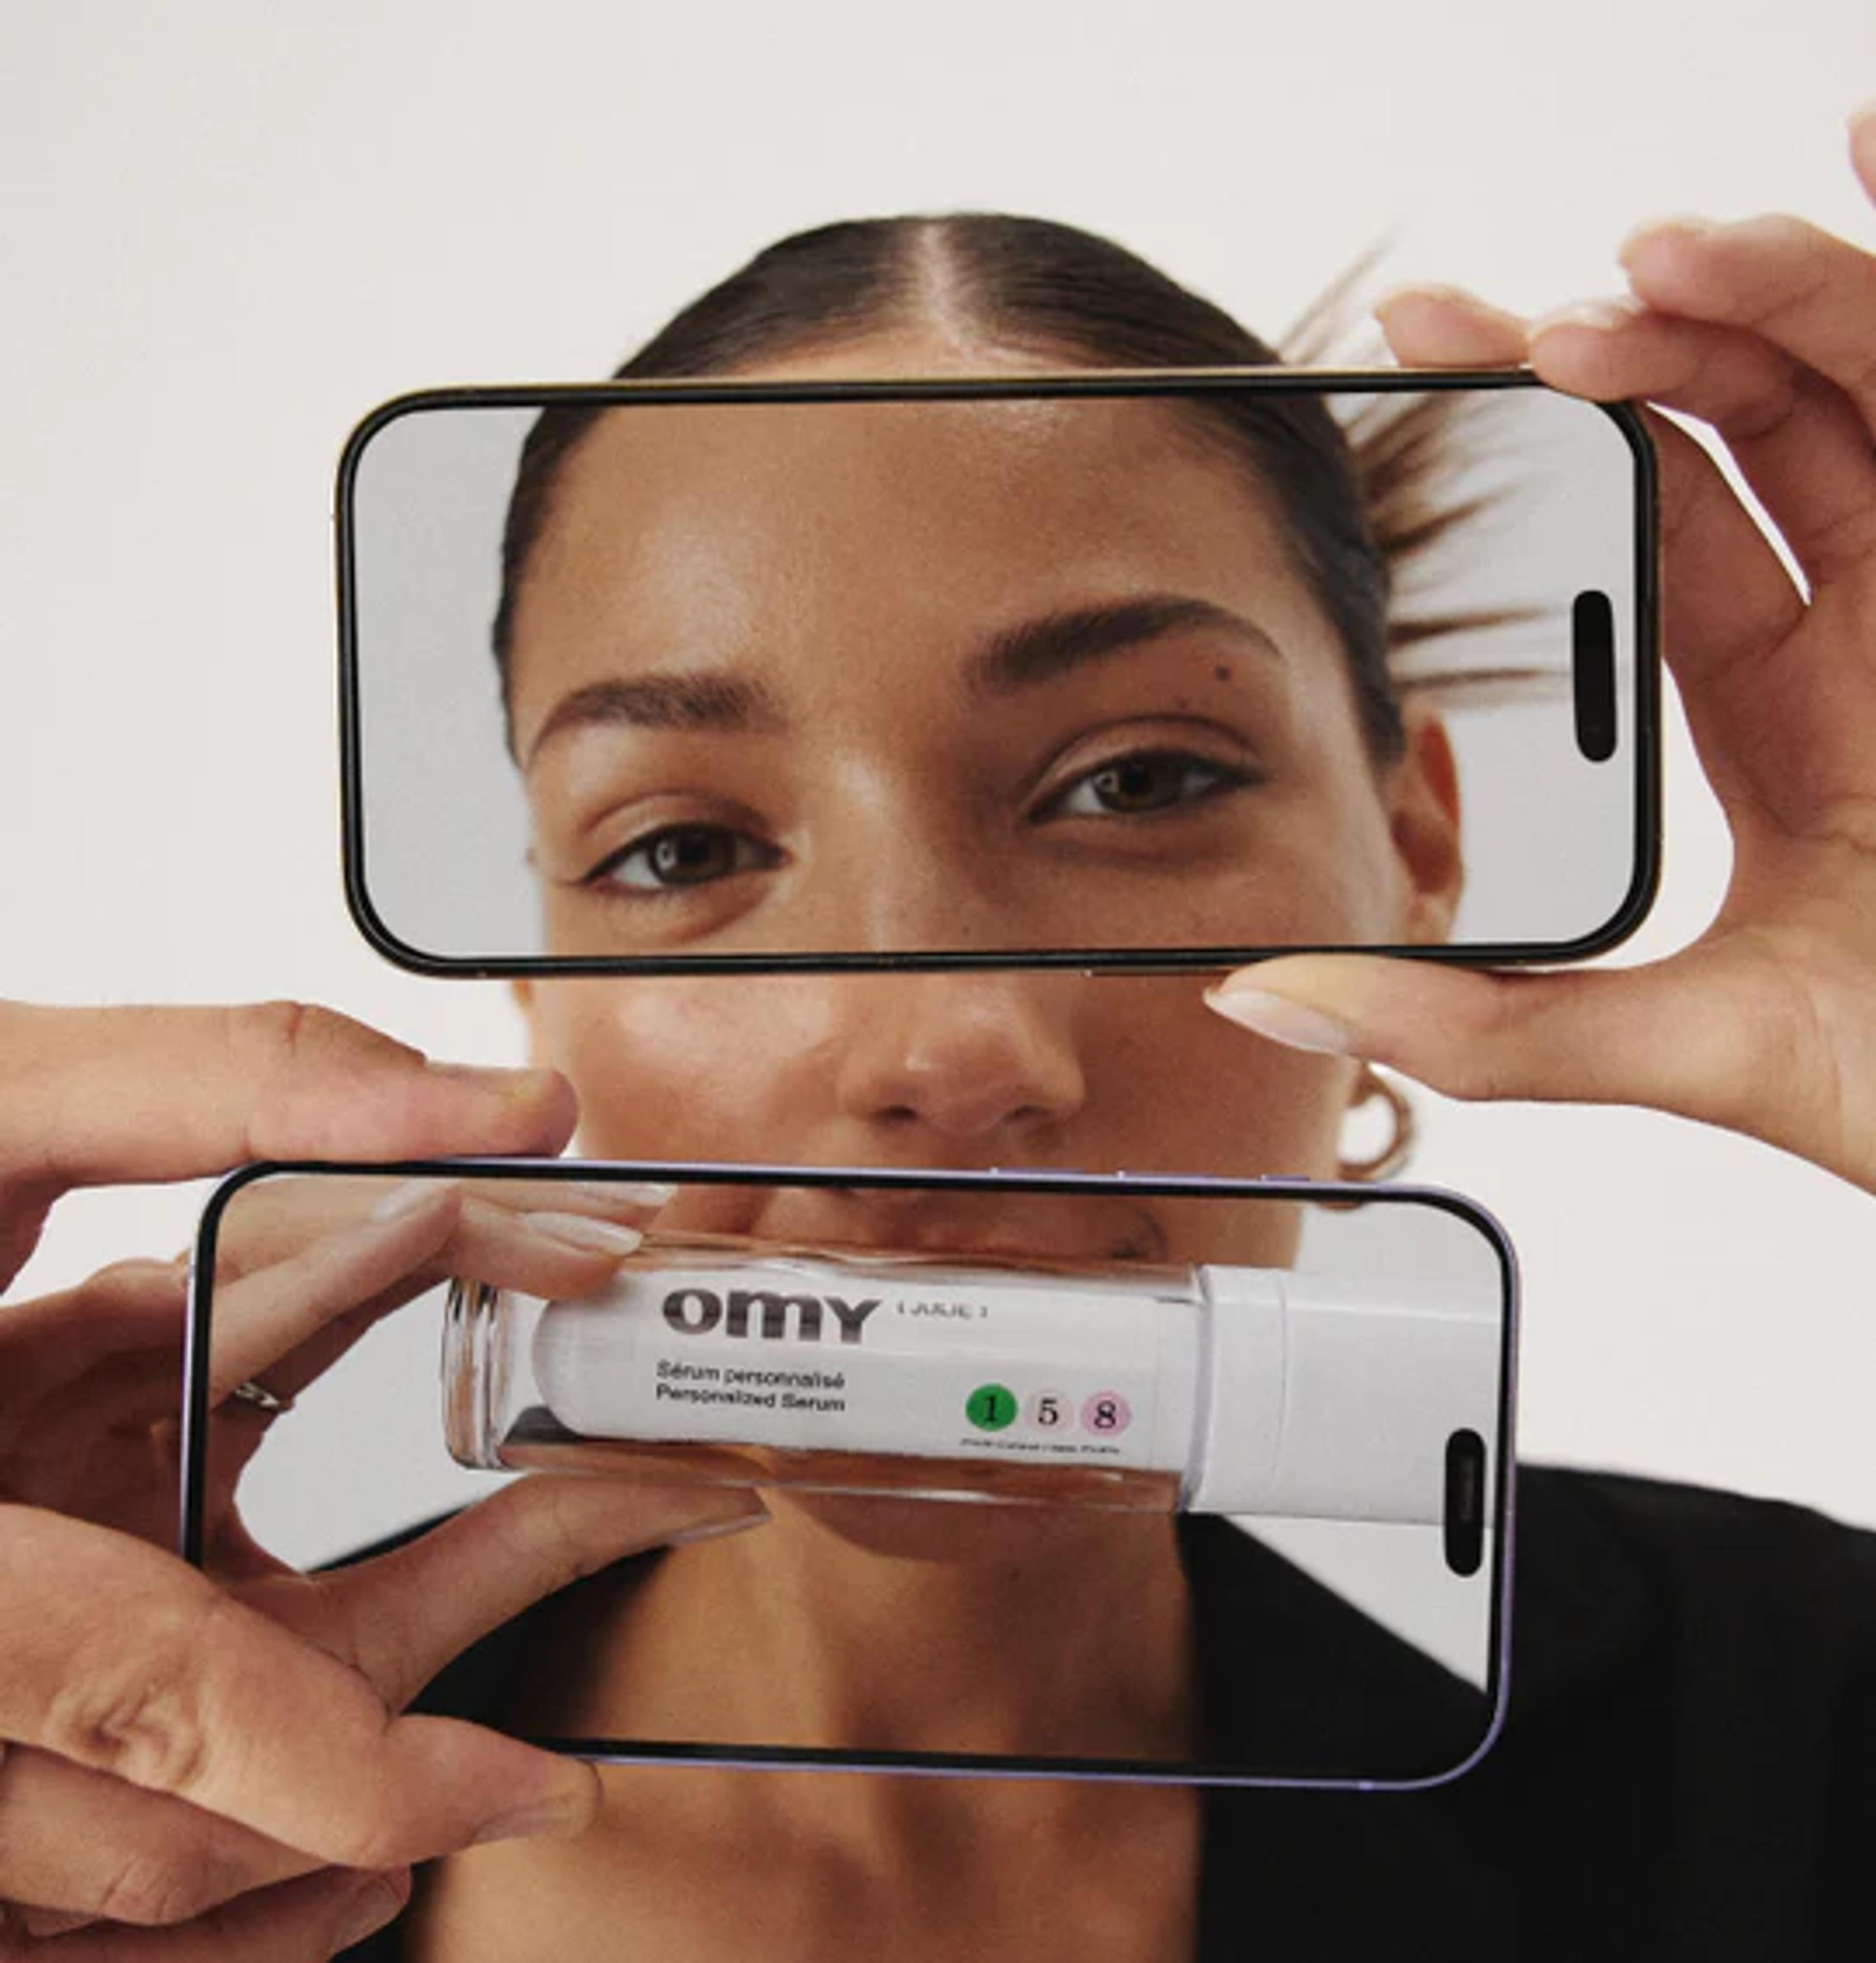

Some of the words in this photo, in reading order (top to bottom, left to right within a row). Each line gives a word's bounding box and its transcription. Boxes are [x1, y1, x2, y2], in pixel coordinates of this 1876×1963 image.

[657, 1359, 720, 1381] Sérum
[725, 1368, 845, 1389] personnalisé
[657, 1383, 776, 1408] Personalized
[782, 1392, 845, 1411] Serum
[983, 1395, 996, 1423] 1
[1038, 1397, 1058, 1425] 5
[1094, 1400, 1116, 1429] 8
